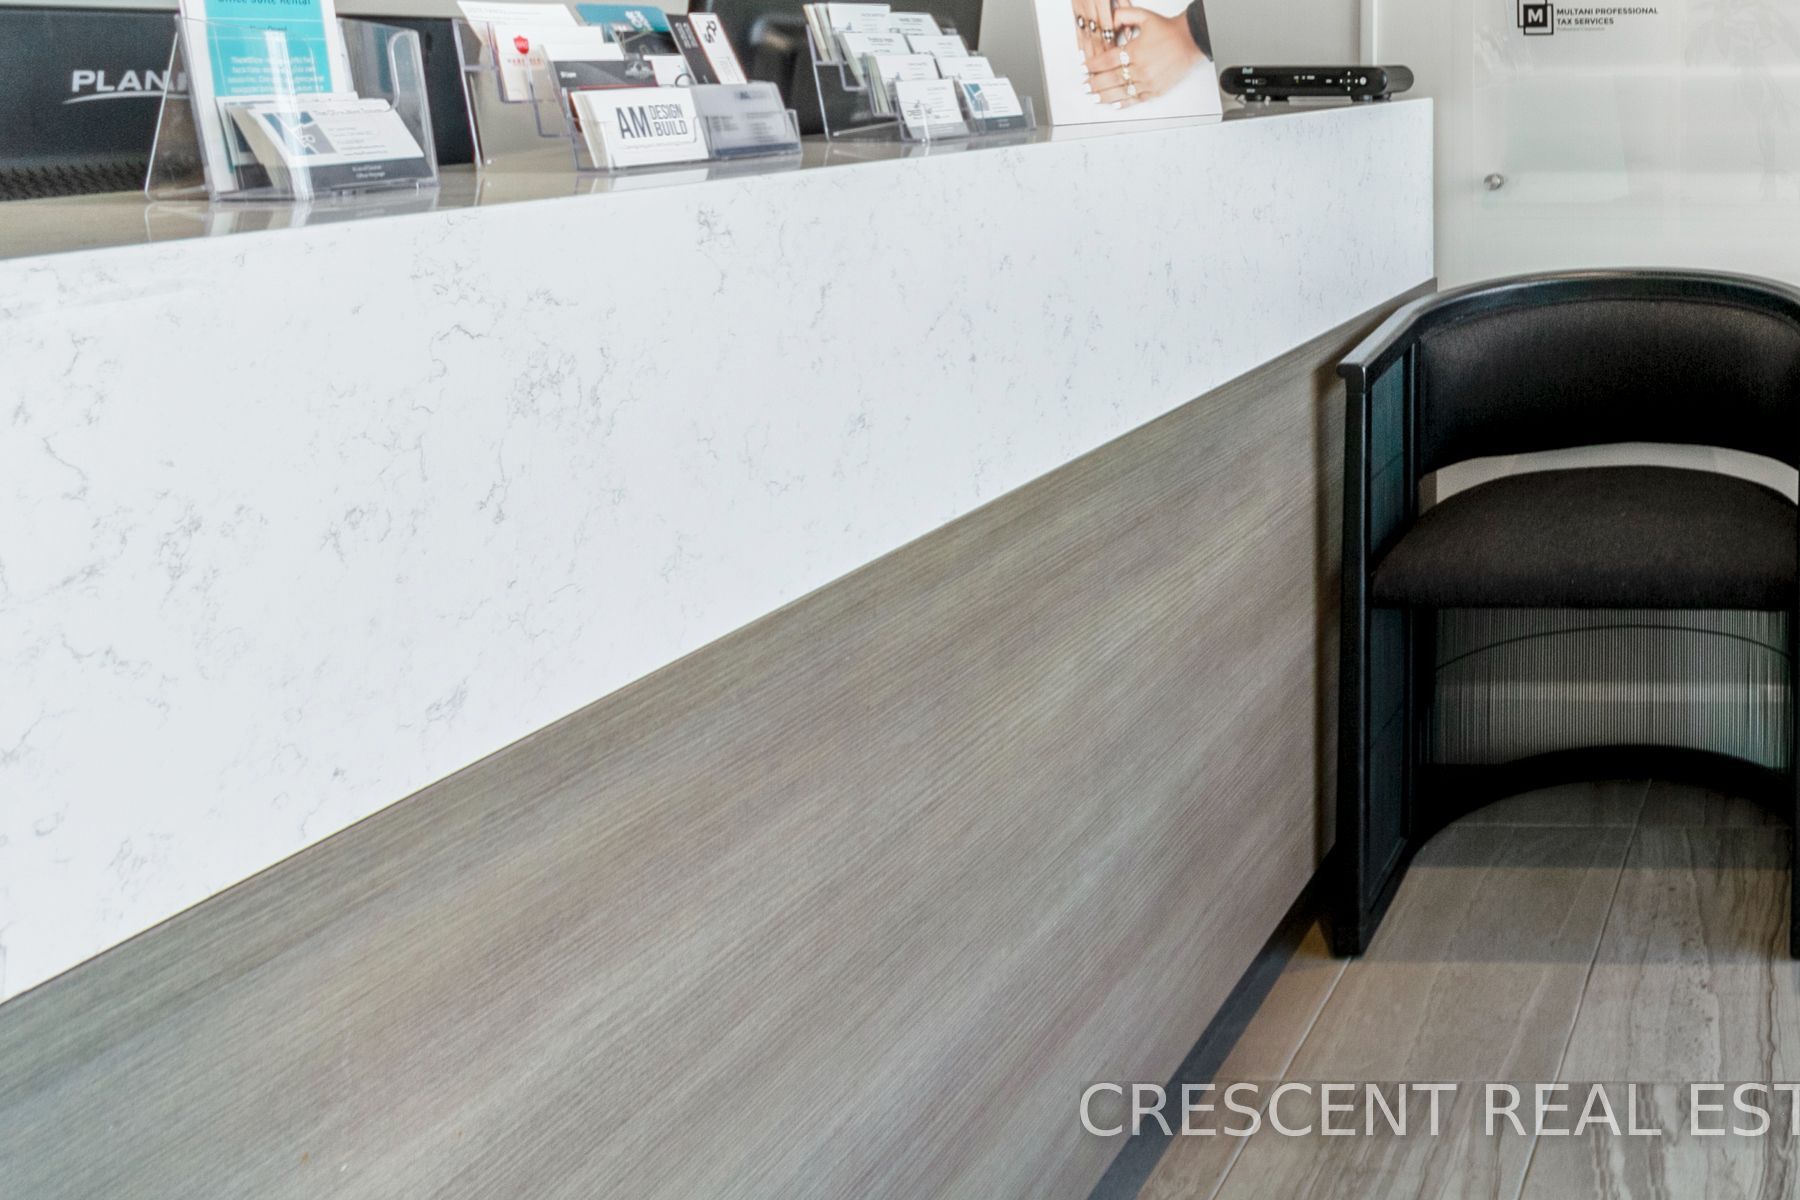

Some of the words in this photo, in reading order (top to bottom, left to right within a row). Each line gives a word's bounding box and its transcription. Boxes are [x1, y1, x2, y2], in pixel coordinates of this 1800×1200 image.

[1528, 9, 1543, 23] M
[649, 104, 683, 119] DESIGN
[615, 107, 653, 139] AM
[654, 120, 688, 136] BUILD
